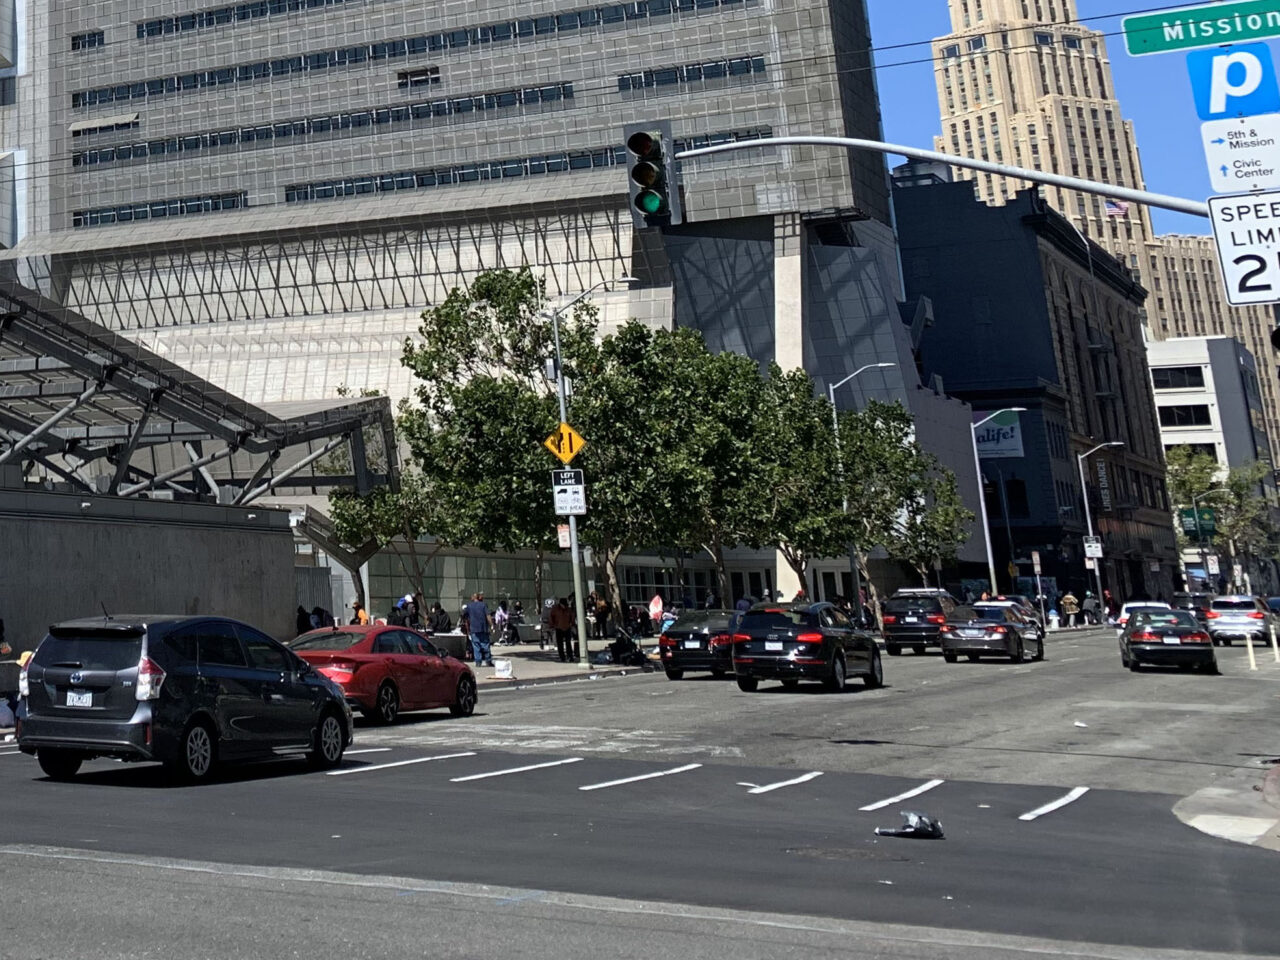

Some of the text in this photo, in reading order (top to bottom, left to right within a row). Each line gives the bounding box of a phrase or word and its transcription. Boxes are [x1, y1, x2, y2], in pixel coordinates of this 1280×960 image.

[1162, 11, 1280, 42] Mission
[1227, 128, 1258, 140] 5th &
[1229, 138, 1275, 149] Mission
[1233, 159, 1262, 169] Civic
[1235, 168, 1275, 179] Center
[1221, 202, 1280, 222] SPEE
[1231, 227, 1280, 246] LIM
[1232, 252, 1280, 293] 2
